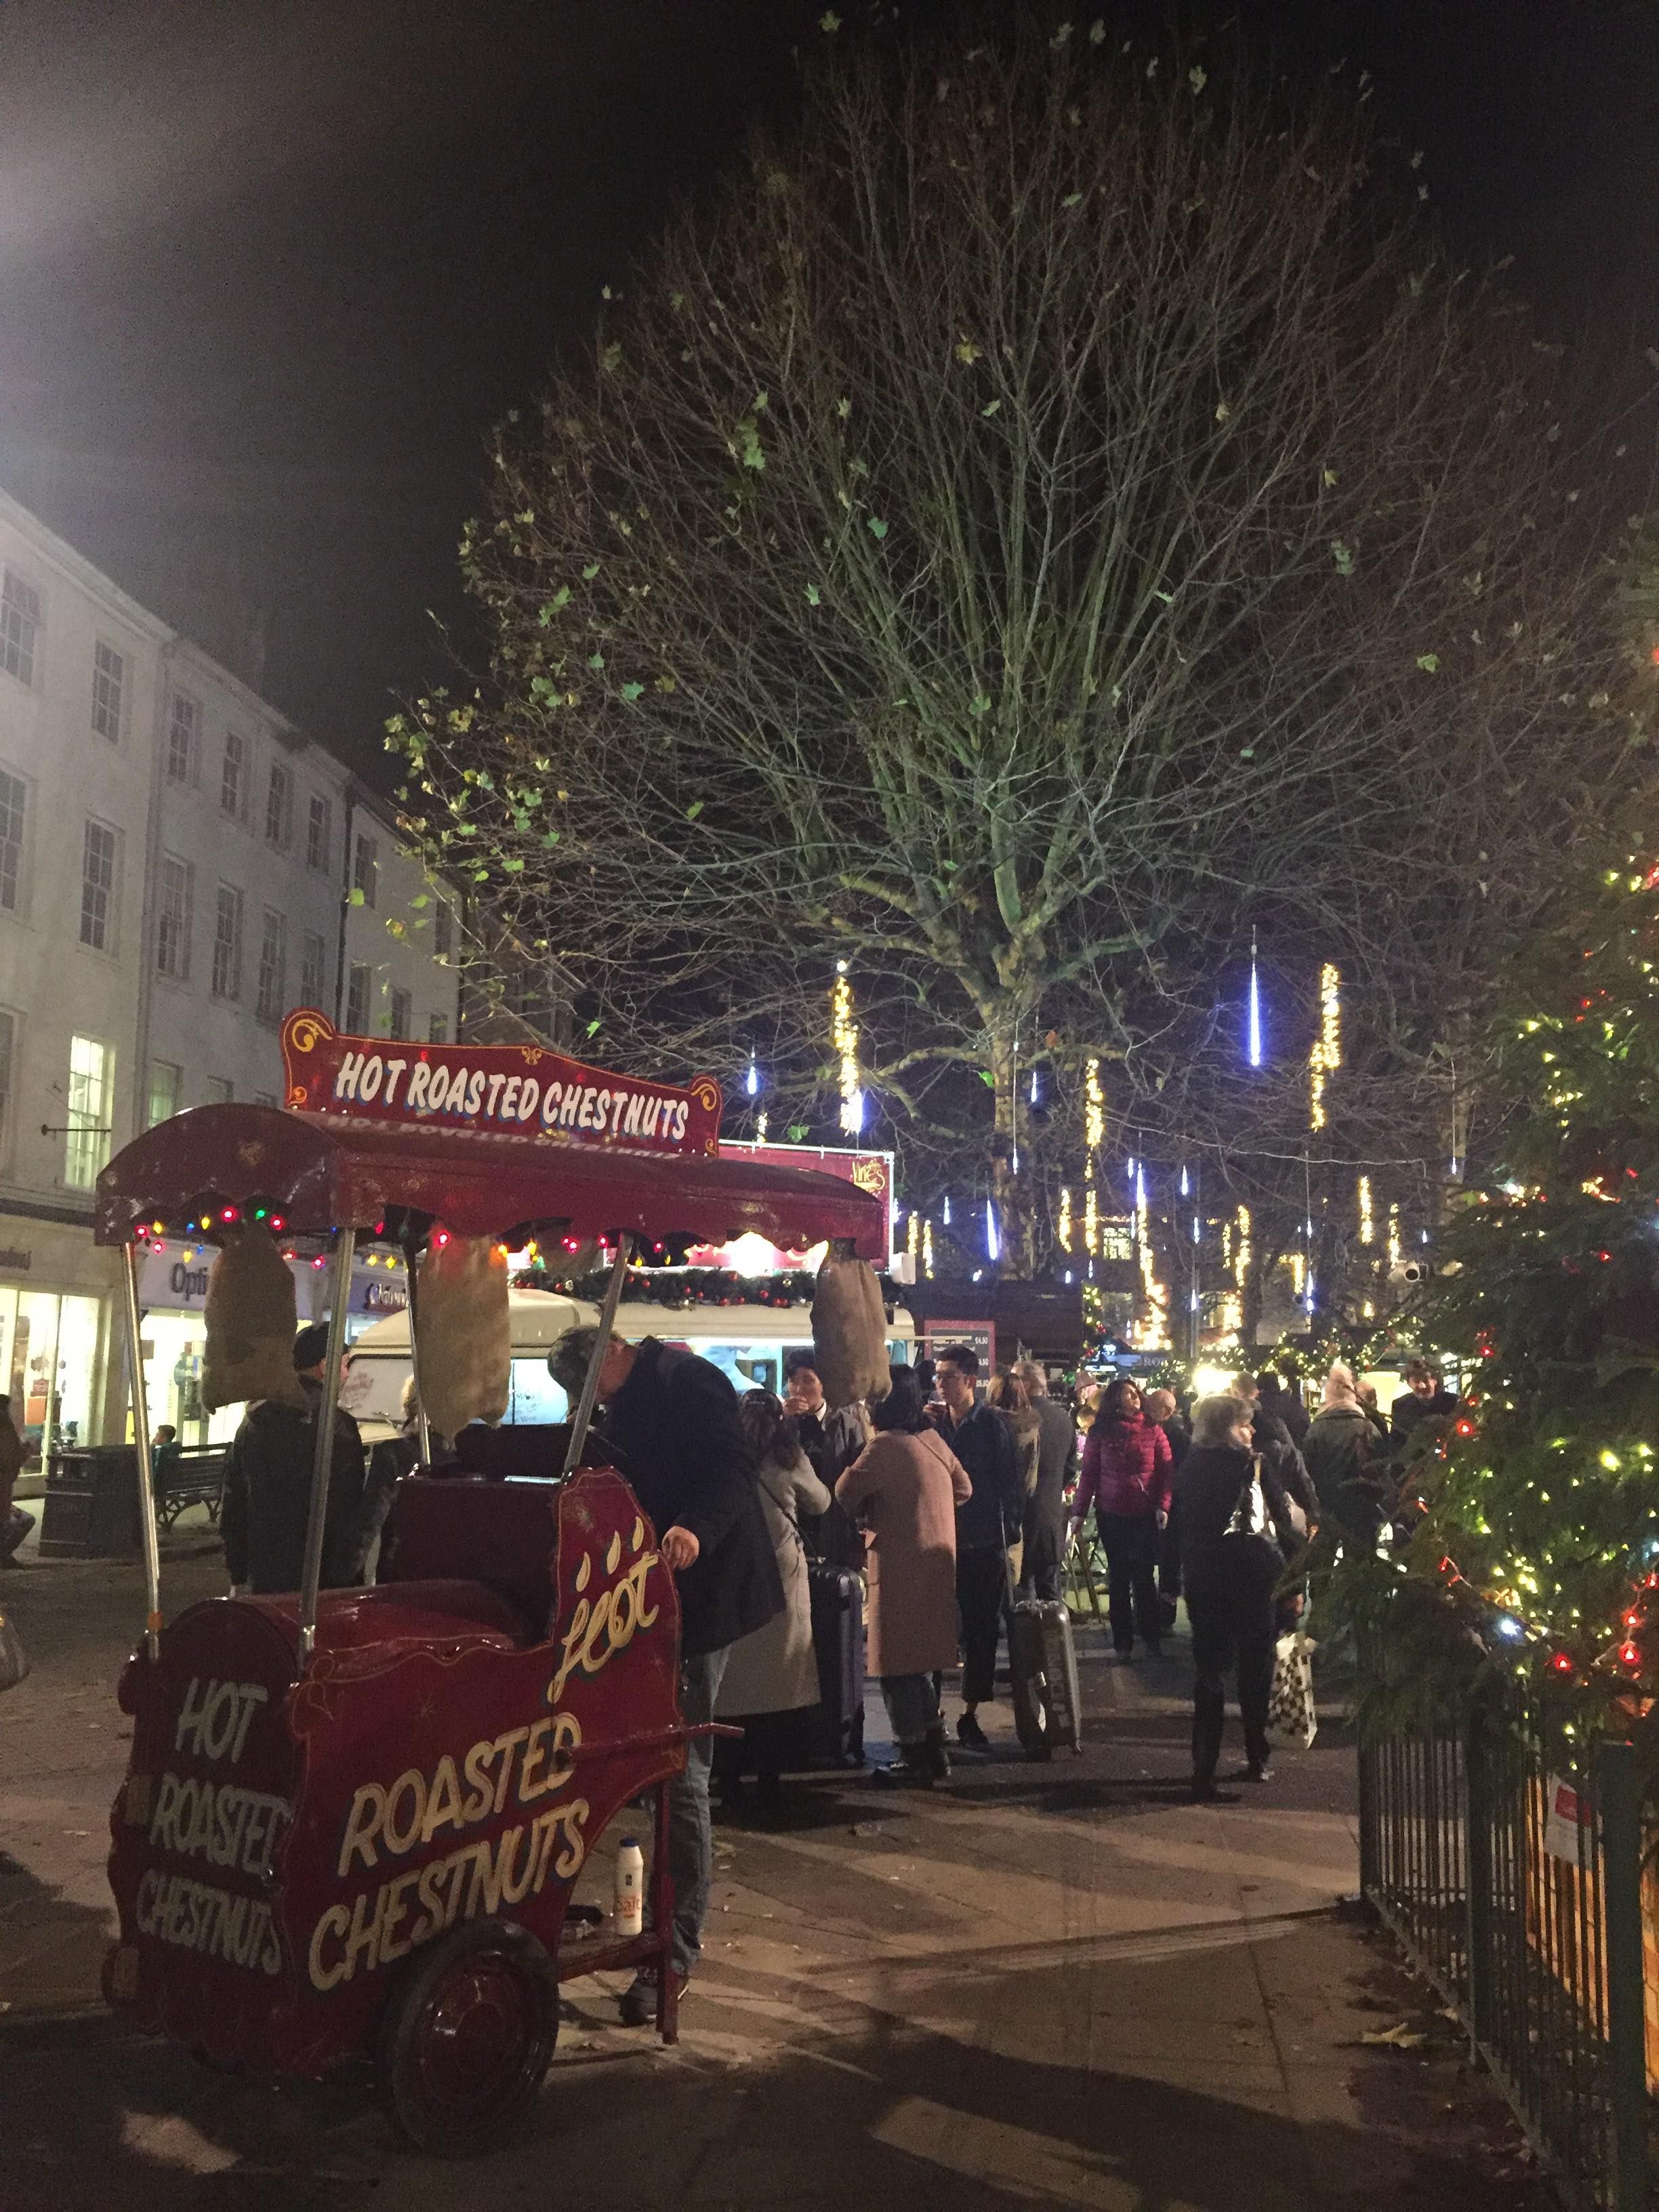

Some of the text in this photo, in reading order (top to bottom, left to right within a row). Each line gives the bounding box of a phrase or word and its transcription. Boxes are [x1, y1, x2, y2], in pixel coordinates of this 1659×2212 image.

[335, 1051, 406, 1105] HOT
[407, 1061, 539, 1120] ROASTED
[542, 1080, 689, 1140] CHESTNUTS
[174, 1677, 269, 1763] HOT
[338, 1712, 581, 1877] ROASTED
[136, 1868, 282, 1976] CHESTNUTS
[308, 1798, 590, 1992] CHESTNUTS
